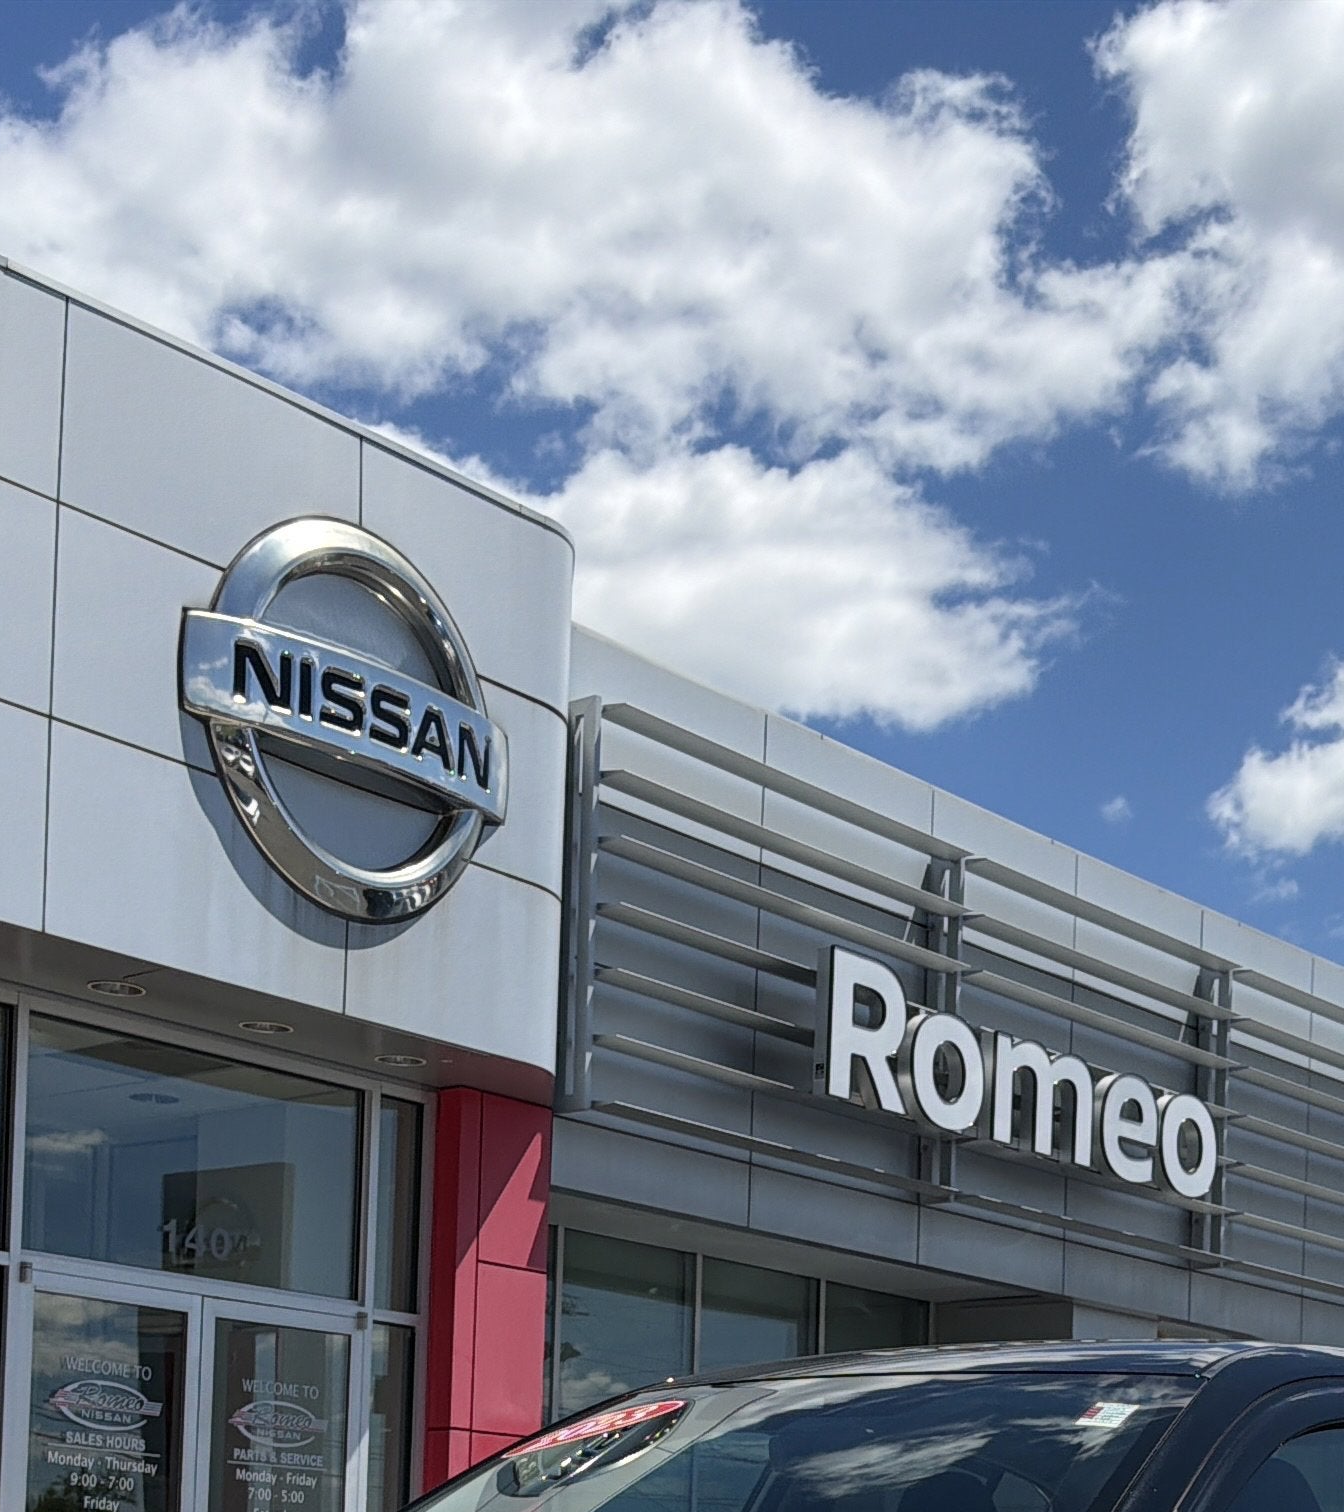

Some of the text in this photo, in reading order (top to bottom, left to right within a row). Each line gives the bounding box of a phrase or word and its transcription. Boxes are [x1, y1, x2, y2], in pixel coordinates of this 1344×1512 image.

[233, 638, 492, 794] NISSAN
[825, 945, 1218, 1199] Romeo
[163, 1219, 231, 1260] 140
[64, 1356, 152, 1381] WELCOME TO
[73, 1382, 143, 1412] Romeo
[242, 1378, 319, 1400] WELCOME TO
[81, 1410, 132, 1423] NISSAN
[66, 1431, 146, 1452] SALES HOURS
[47, 1450, 95, 1471] Monday
[105, 1456, 158, 1476] Thursday
[233, 1448, 267, 1461] PARTS
[280, 1452, 323, 1467] SERVICE
[70, 1472, 97, 1487] 9:00
[108, 1476, 134, 1491] 7:00
[236, 1468, 277, 1485] Monday
[286, 1472, 317, 1489] Friday
[248, 1487, 272, 1501] 7:00
[281, 1489, 304, 1503] 5:00
